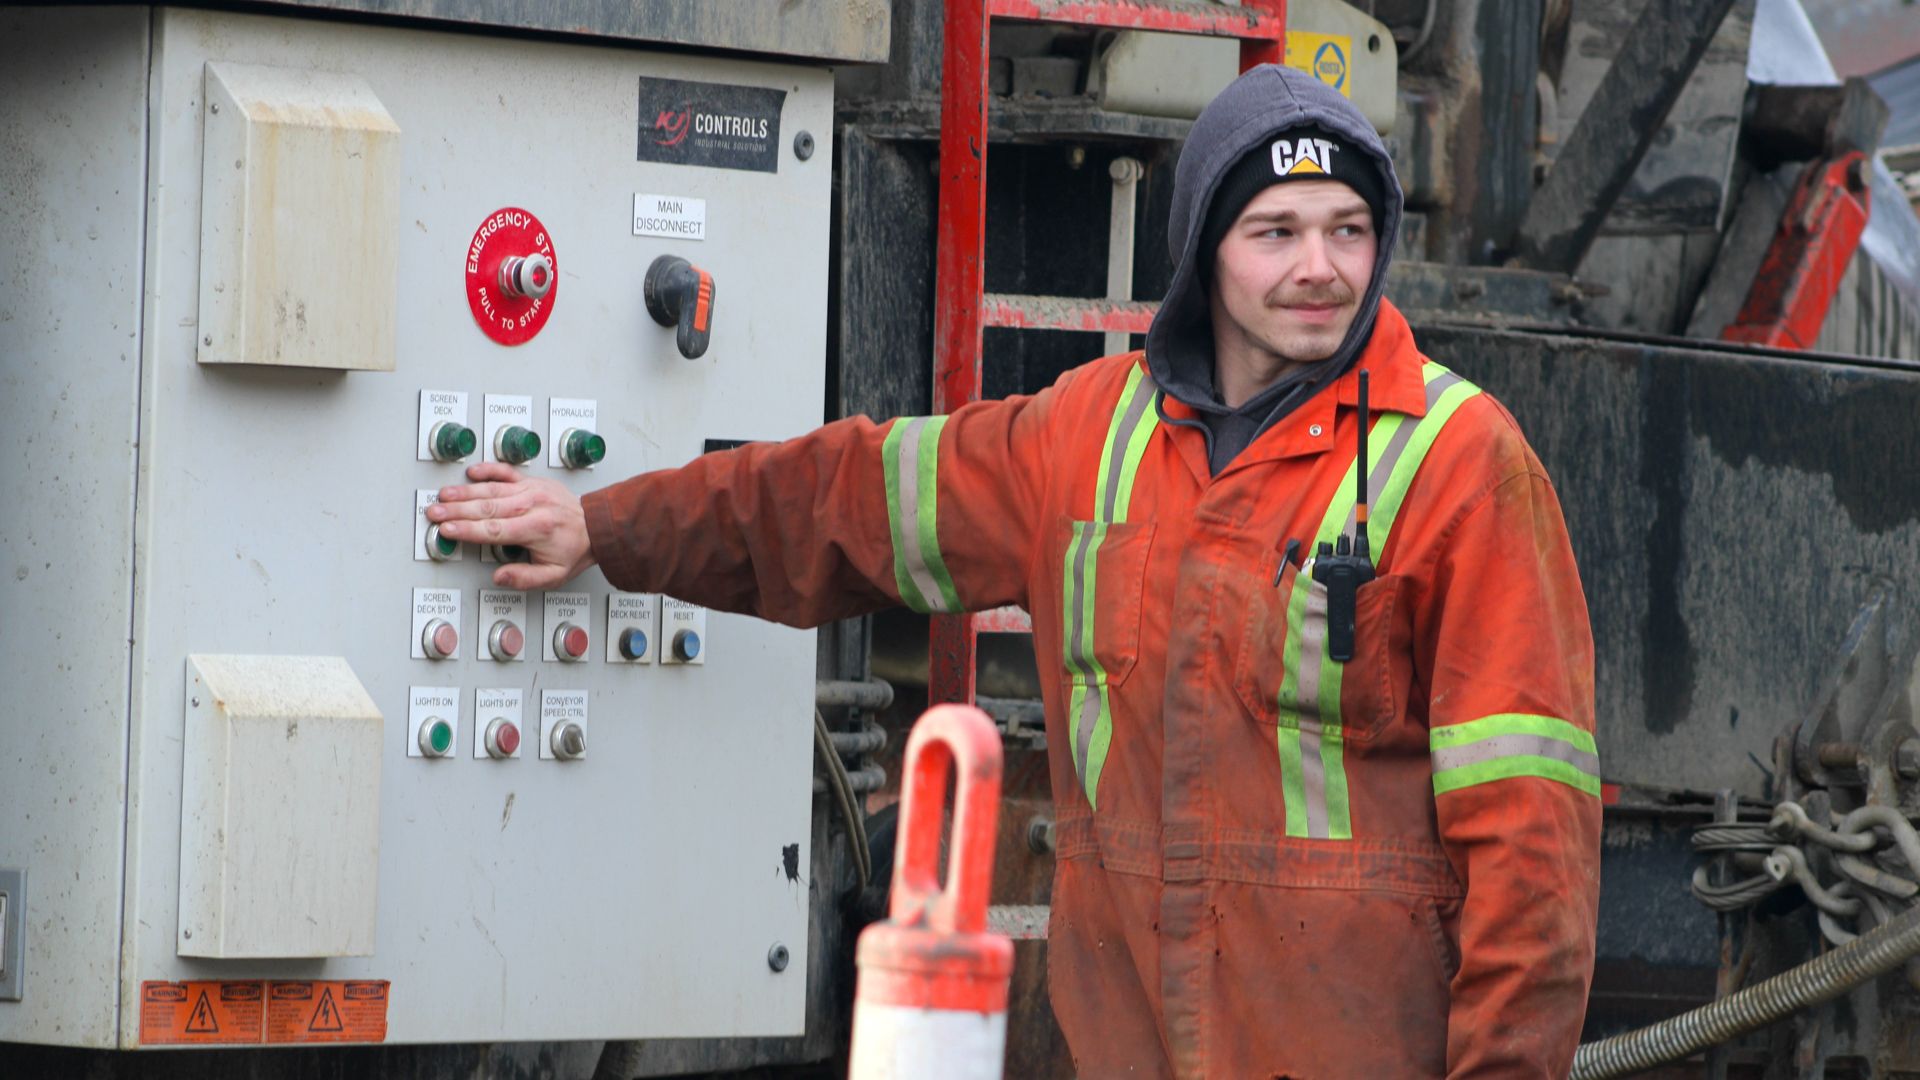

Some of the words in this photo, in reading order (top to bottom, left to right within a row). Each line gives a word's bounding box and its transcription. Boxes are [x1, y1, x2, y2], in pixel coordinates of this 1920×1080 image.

[695, 113, 768, 139] CONTROLS
[694, 138, 731, 150] INDUSTRIAL
[733, 141, 767, 152] SOLUTIONS
[1271, 138, 1333, 176] CAT
[657, 200, 683, 214] MAIN
[636, 216, 702, 235] DISCONNECT
[468, 211, 531, 274] EMERGENCY
[535, 232, 554, 281] STO
[478, 286, 496, 321] PULL
[502, 317, 514, 330] TO
[520, 298, 542, 327] STAR
[430, 394, 458, 404] SCREEN
[434, 405, 453, 415] DECK
[488, 404, 528, 415] CONVEYOR
[551, 408, 595, 418] HYDRAULICS
[423, 593, 452, 602] SCREEN
[484, 594, 522, 605] CONVEYOR
[546, 596, 588, 607] HYDRAULICS
[618, 599, 645, 608] SCREEN
[417, 604, 436, 614] DECK
[438, 605, 456, 615] STOP
[493, 605, 512, 616] STOP
[558, 608, 576, 618] STOP
[610, 610, 628, 619] DECK
[629, 610, 651, 620] RESET
[673, 611, 694, 621] RESET
[415, 697, 441, 707] LIGHTS
[442, 697, 453, 707] ON
[480, 698, 504, 708] LIGHTS
[505, 698, 519, 708] OFF
[546, 695, 584, 706] CONVEYOR
[544, 709, 567, 718] SPEED
[567, 709, 585, 718] CTRL
